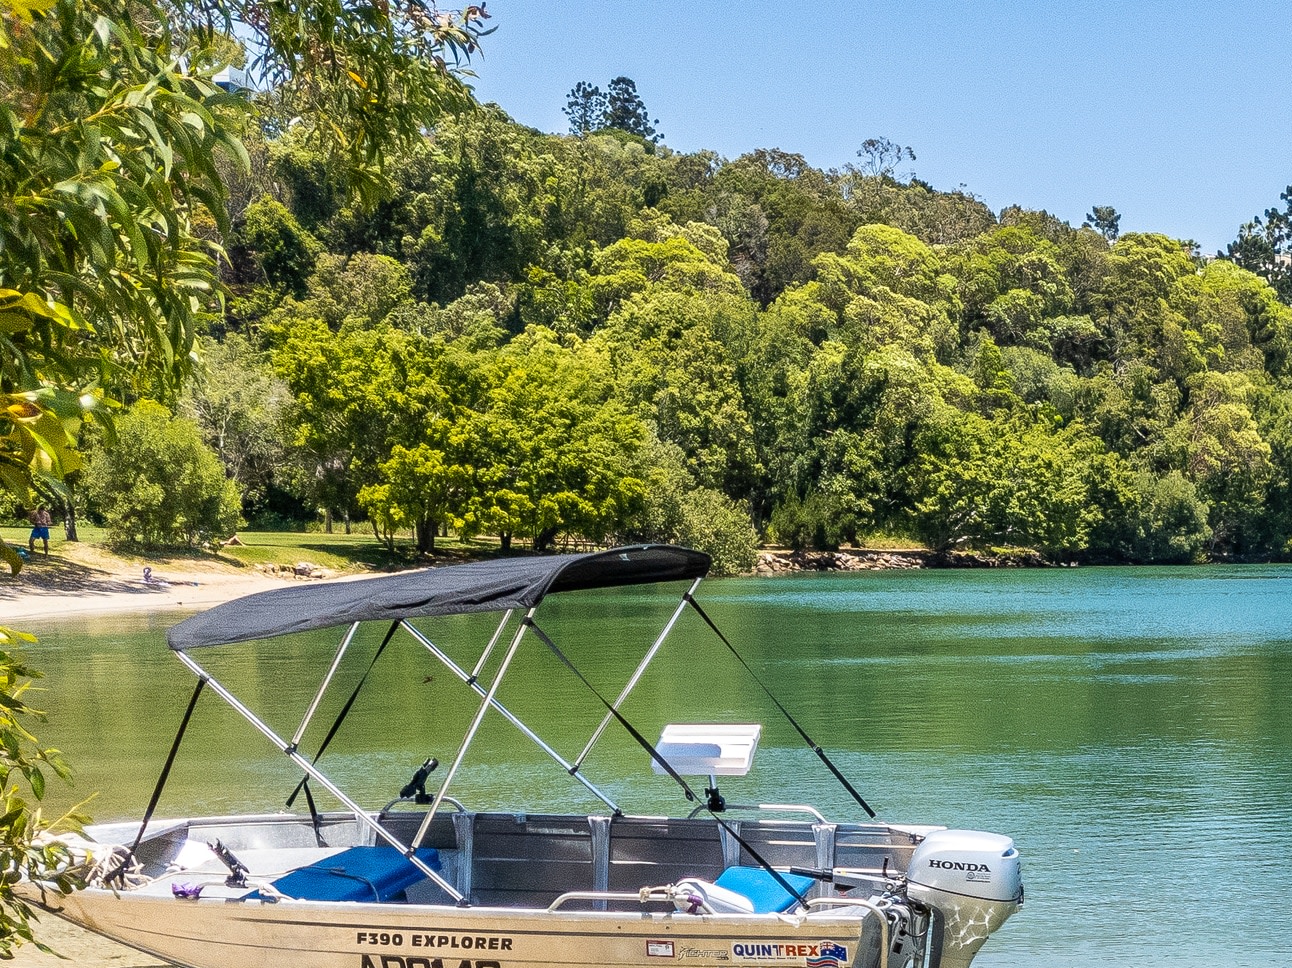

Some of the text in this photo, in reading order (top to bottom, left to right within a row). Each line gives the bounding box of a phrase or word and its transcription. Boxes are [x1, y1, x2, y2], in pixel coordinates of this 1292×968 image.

[929, 859, 991, 873] HONDA
[356, 932, 513, 950] F390 EXPLORER
[733, 943, 819, 958] QUINTREX
